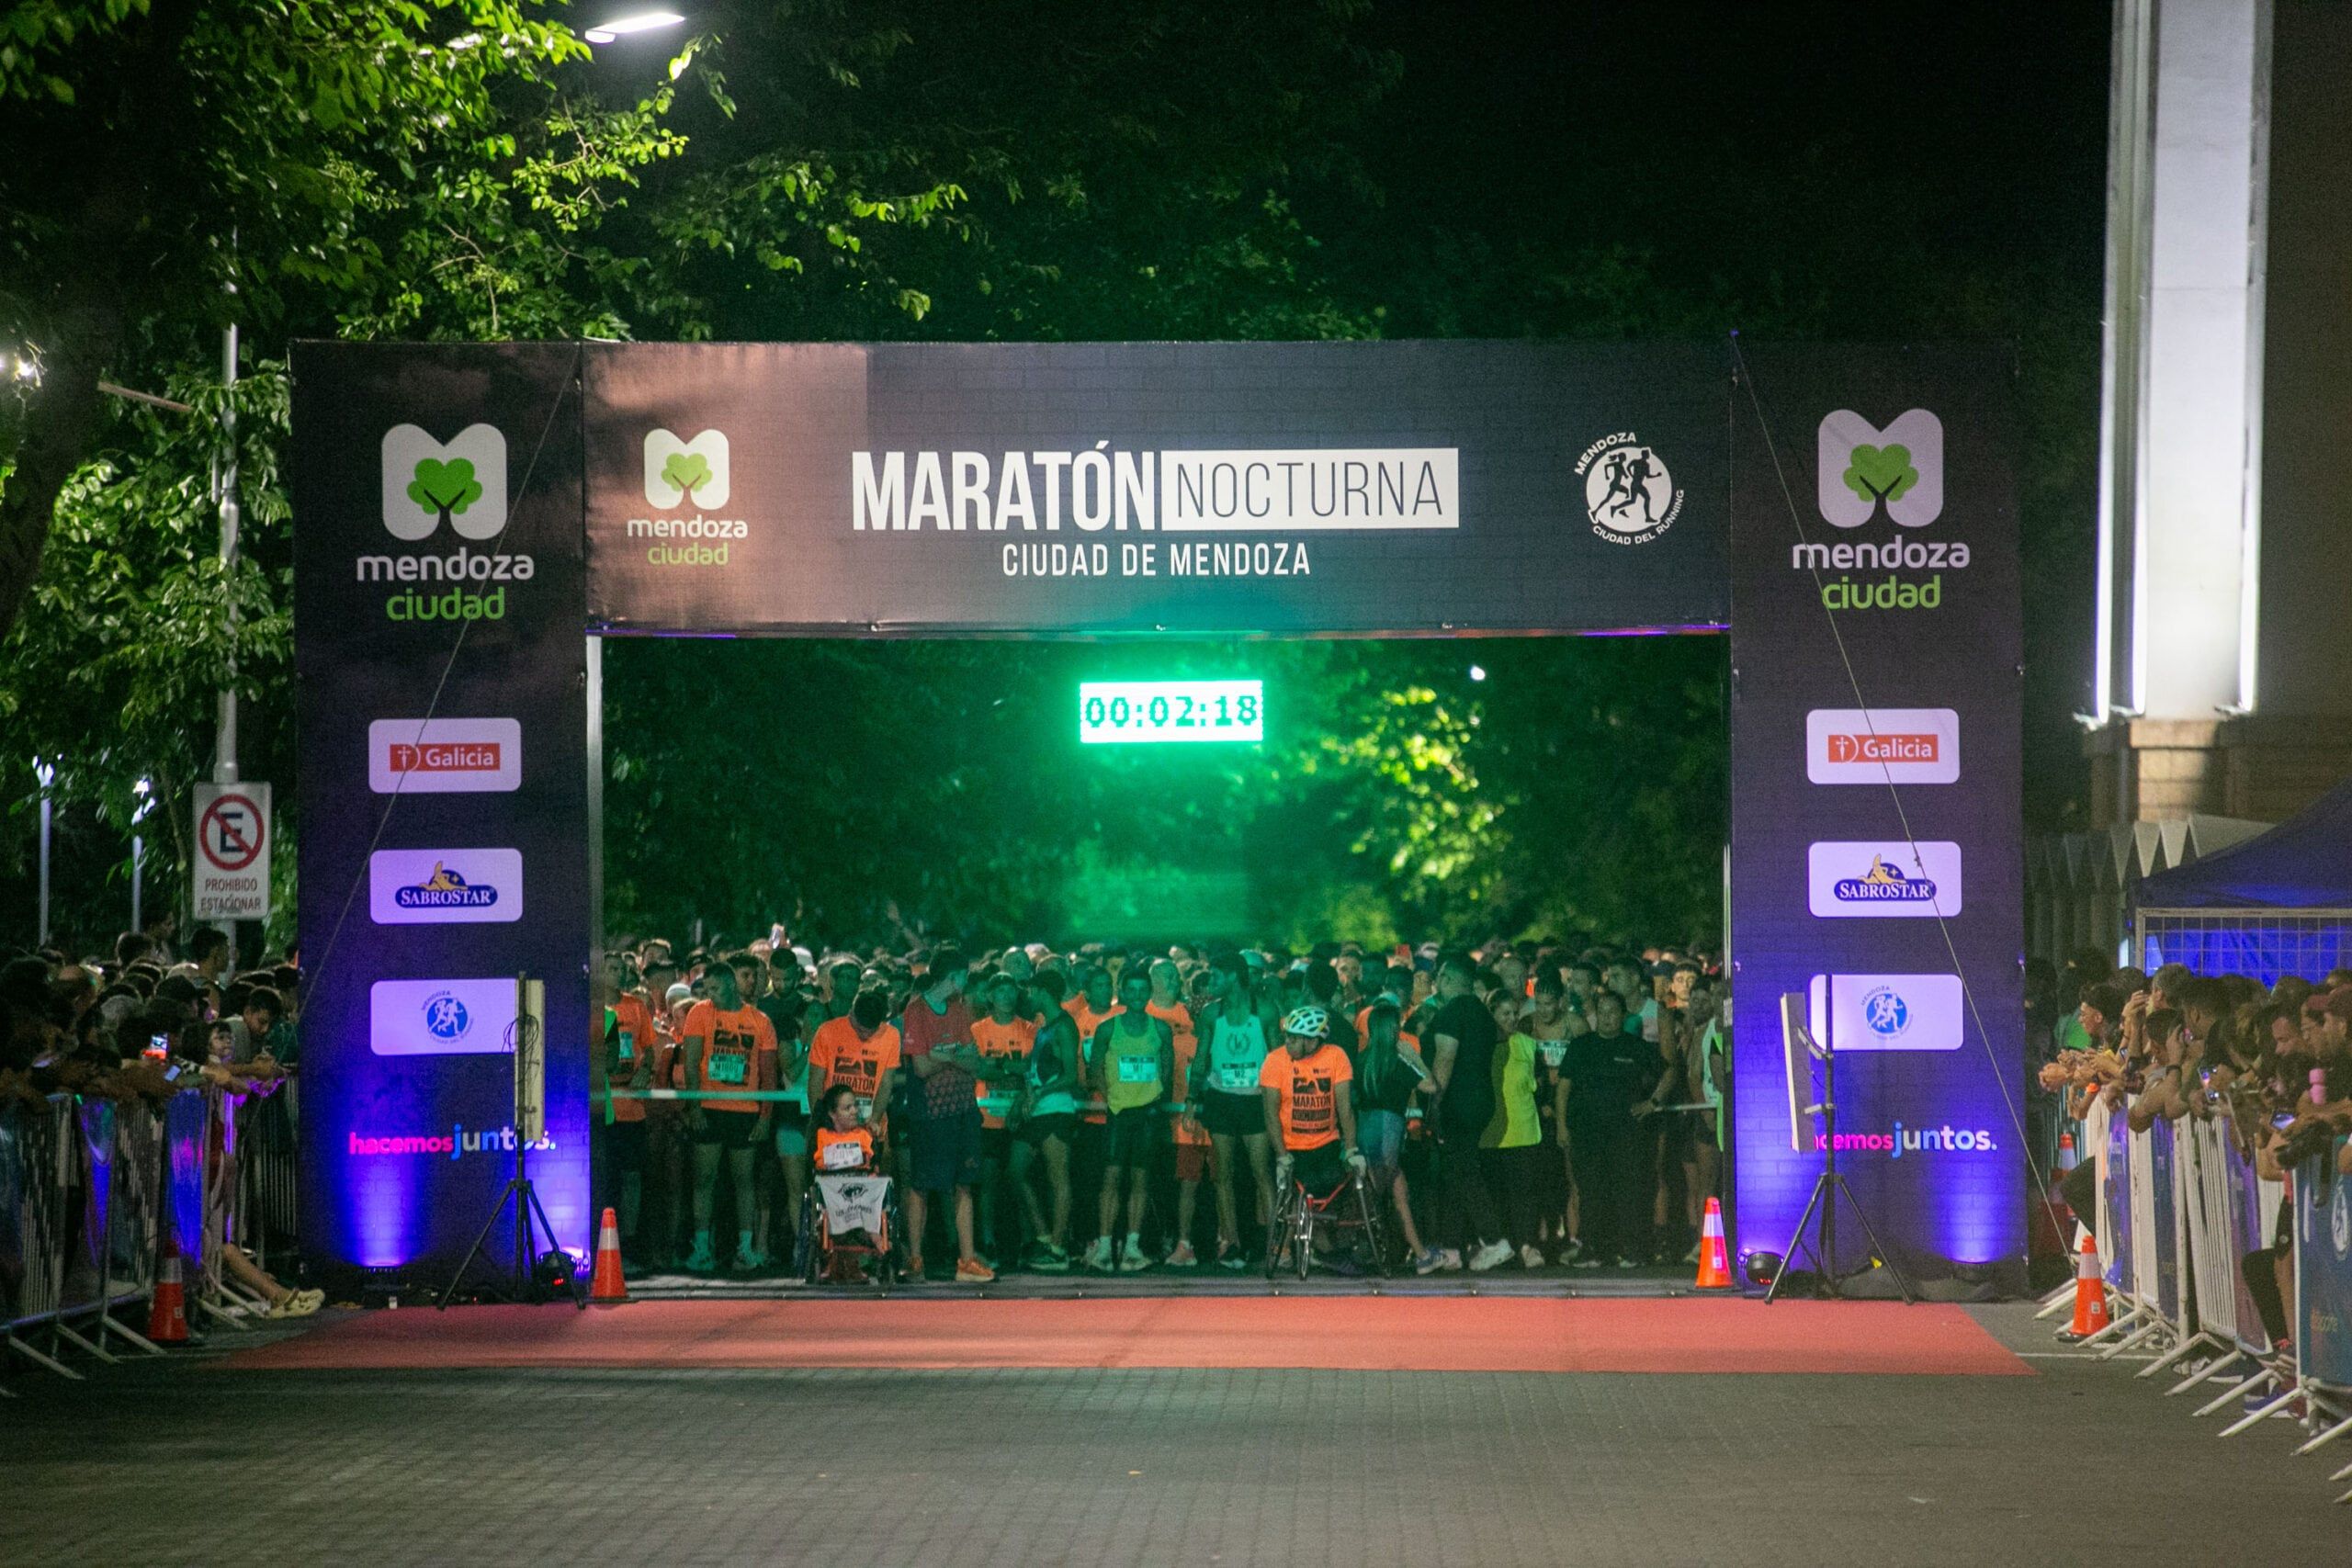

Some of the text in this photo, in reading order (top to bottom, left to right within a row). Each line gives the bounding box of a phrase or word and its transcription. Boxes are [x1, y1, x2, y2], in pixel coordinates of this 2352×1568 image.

[1574, 432, 1637, 475] MENDOZA
[852, 440, 1443, 531] MARATÓN NOCTURNA
[628, 513, 748, 538] mendoza
[1593, 489, 1685, 546] CIUDAD DEL RUNNING
[356, 547, 535, 581] mendoza
[648, 542, 729, 565] ciudad
[1002, 542, 1311, 577] CIUDAD DE MENDOZA
[1792, 535, 1971, 570] mendoza
[386, 586, 505, 621] ciudad
[1822, 574, 1941, 610] ciudad
[1085, 695, 1258, 728] 00:02:18
[425, 747, 495, 767] Galicia
[1863, 738, 1933, 758] Galicia
[205, 877, 258, 892] PROHIBIDO
[401, 889, 492, 906] SABROSTAR
[1839, 882, 1930, 898] SABROSTAR
[200, 897, 262, 911] ESTACIONAR
